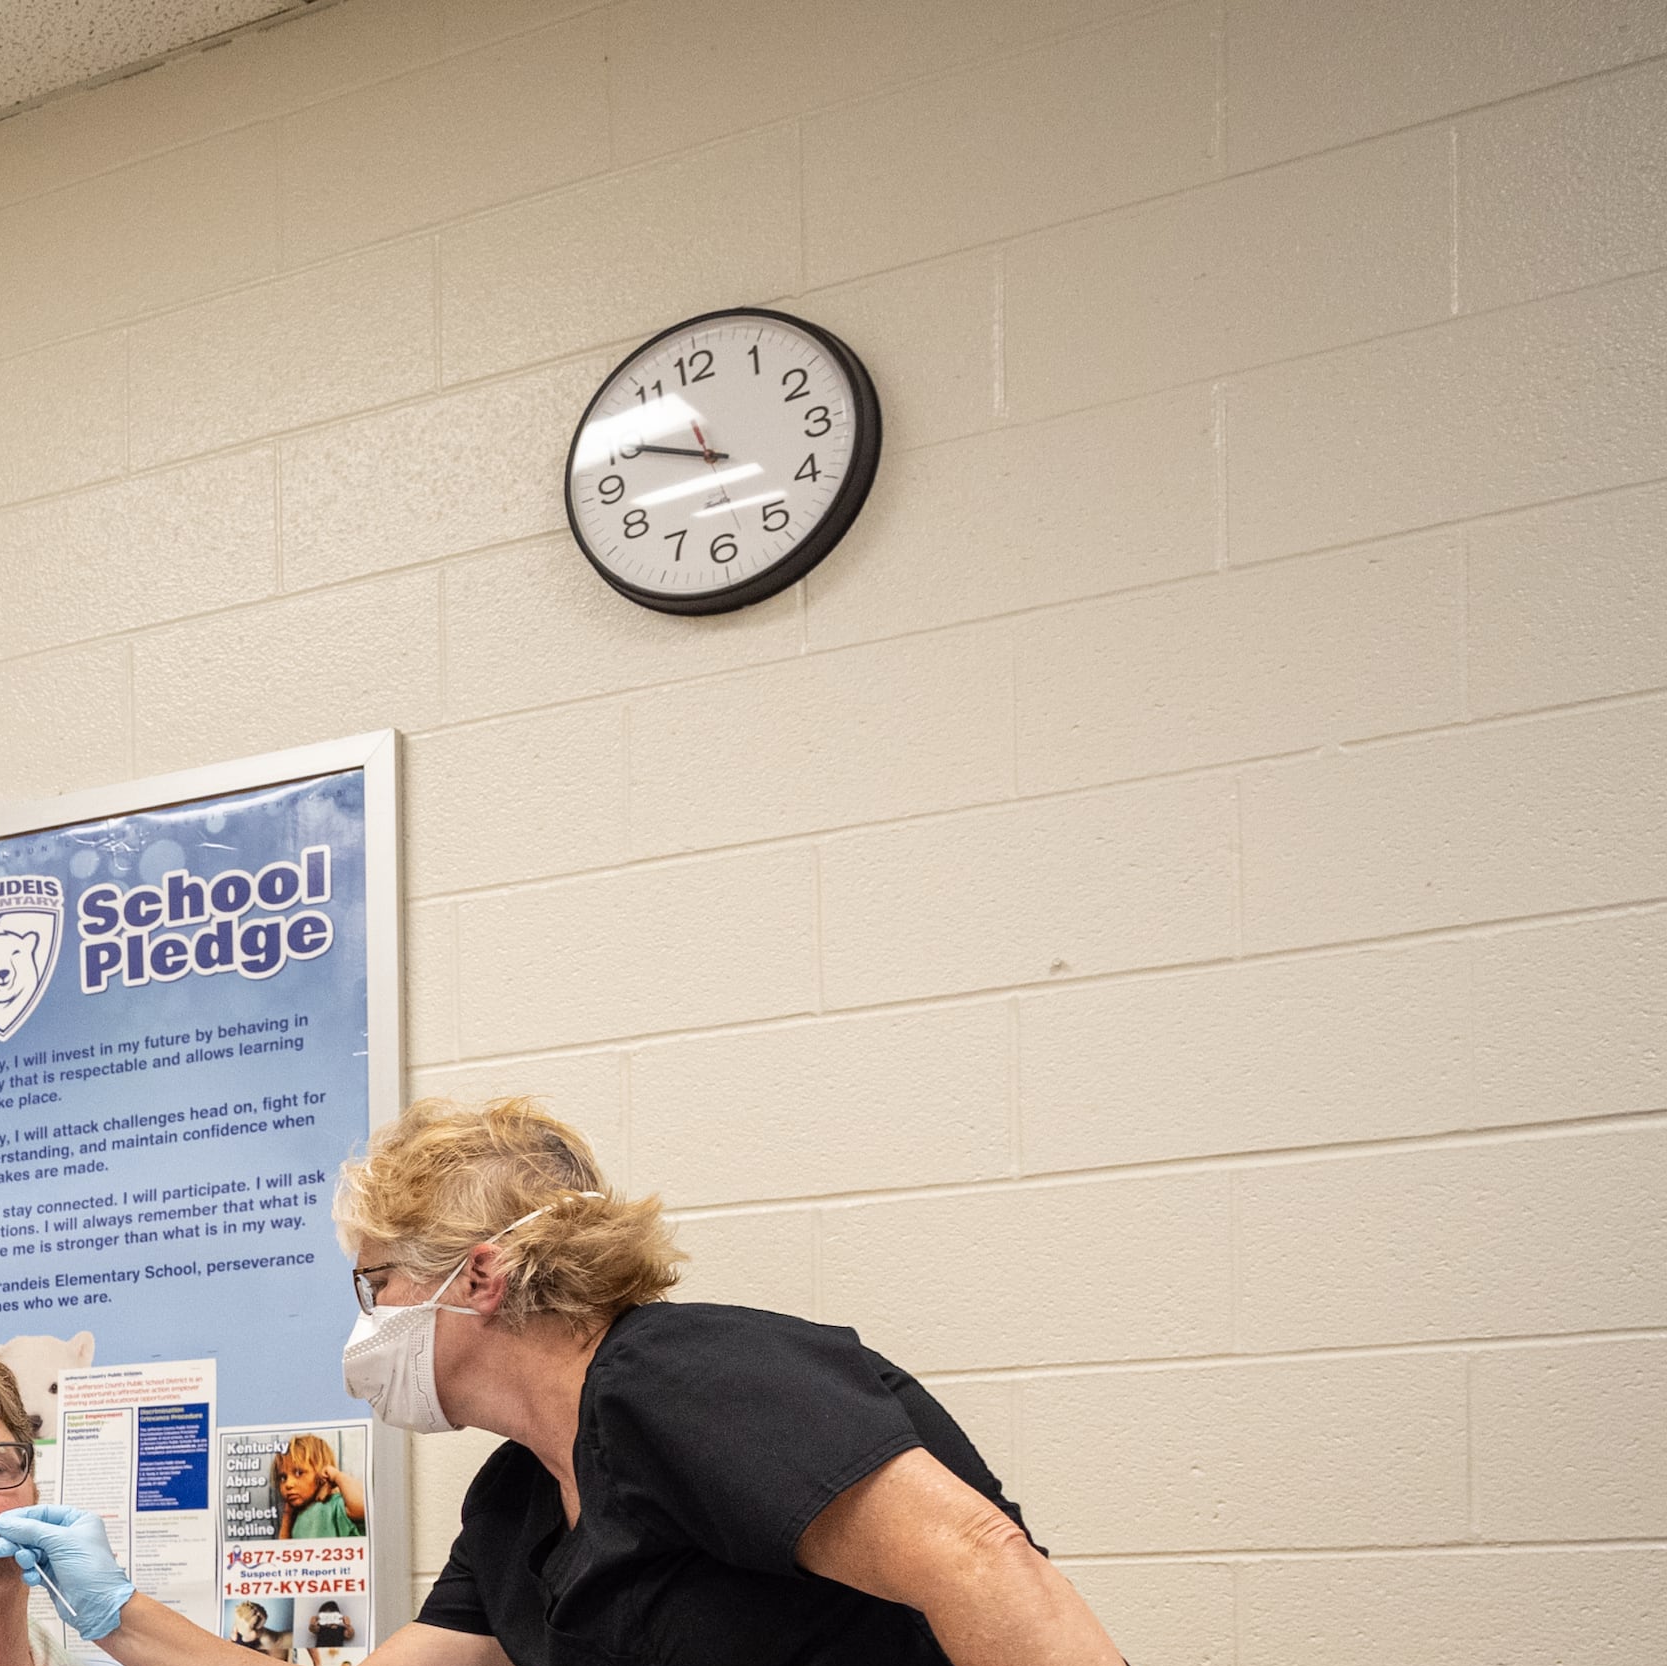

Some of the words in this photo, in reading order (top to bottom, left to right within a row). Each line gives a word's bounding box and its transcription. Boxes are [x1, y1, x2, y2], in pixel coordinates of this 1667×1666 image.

[673, 349, 716, 386] 12
[747, 344, 760, 375] 1
[635, 380, 663, 406] 11
[781, 368, 810, 402] 2
[803, 405, 832, 437] 3
[794, 453, 822, 484] 4
[598, 474, 625, 505] 9
[623, 509, 649, 539] 8
[762, 499, 789, 533] 5
[663, 529, 688, 562] 7
[710, 533, 738, 564] 6
[82, 850, 326, 936] School
[85, 916, 329, 988] Pledge
[14, 1055, 18, 1069] I
[23, 1052, 47, 1067] will
[52, 1046, 95, 1063] invest
[100, 1042, 113, 1056] in
[118, 1040, 139, 1055] my
[144, 1033, 190, 1050] future
[195, 1028, 213, 1044] by
[218, 1017, 289, 1039] behaving
[294, 1013, 308, 1027] in
[9, 1074, 38, 1089] that
[43, 1070, 55, 1084] is
[60, 1057, 147, 1082] respectable
[152, 1052, 180, 1068] and
[186, 1047, 234, 1064] allows
[239, 1036, 304, 1057] learning
[19, 1092, 62, 1109] place.
[55, 1267, 140, 1288] Elementary
[145, 1261, 201, 1279] School,
[206, 1253, 315, 1276] perseverance
[23, 1296, 53, 1311] who
[58, 1295, 79, 1307] we
[83, 1292, 112, 1306] are.
[227, 1440, 289, 1455] Kentucky
[226, 1458, 260, 1472] Child
[226, 1475, 266, 1488] Abuse
[226, 1491, 250, 1504] and
[226, 1507, 278, 1522] Neglect
[227, 1524, 275, 1537] Hotline
[227, 1547, 364, 1564] 1-877-597-2331
[224, 1579, 365, 1595] 1-877-KYSAFE1
[240, 1570, 281, 1579] Suspect
[285, 1568, 299, 1577] it?
[301, 1567, 336, 1578] Report
[340, 1567, 350, 1576] it!
